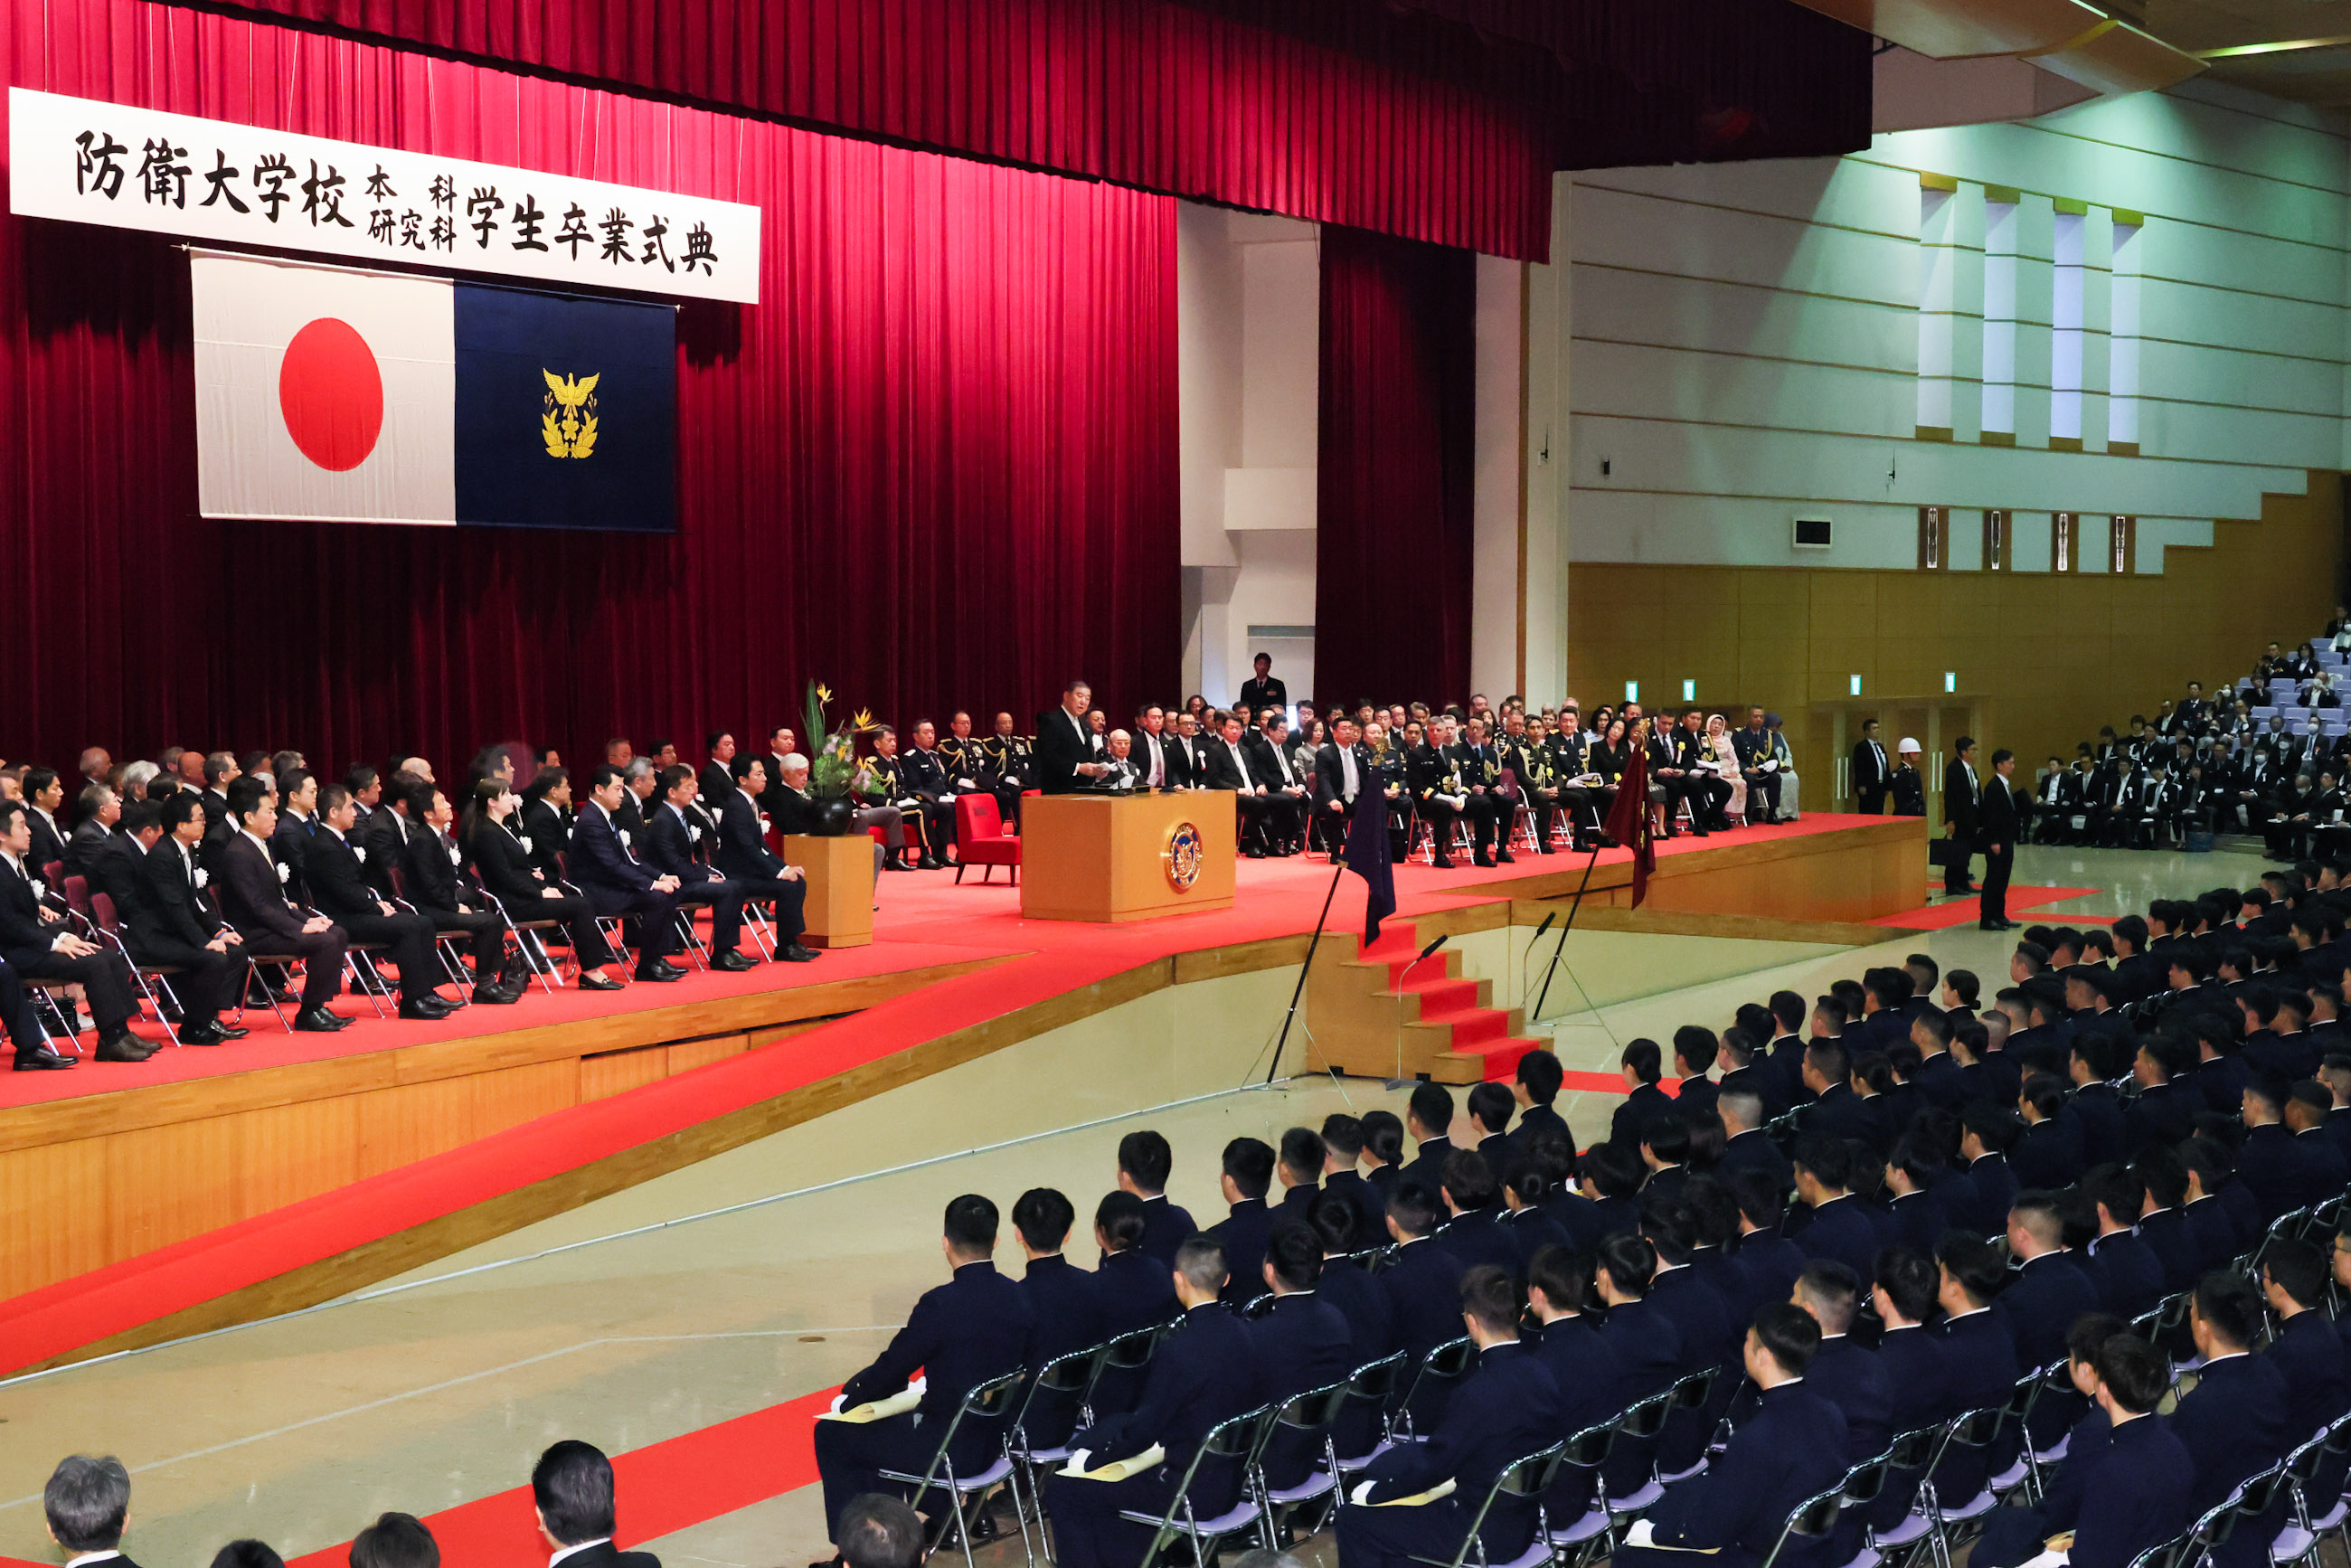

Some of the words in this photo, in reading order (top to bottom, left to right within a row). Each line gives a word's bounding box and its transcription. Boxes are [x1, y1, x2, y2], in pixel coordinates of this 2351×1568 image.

[75, 129, 355, 228] 防衛大学校
[367, 208, 458, 253] 研究科
[467, 185, 719, 278] 学生卒業式典
